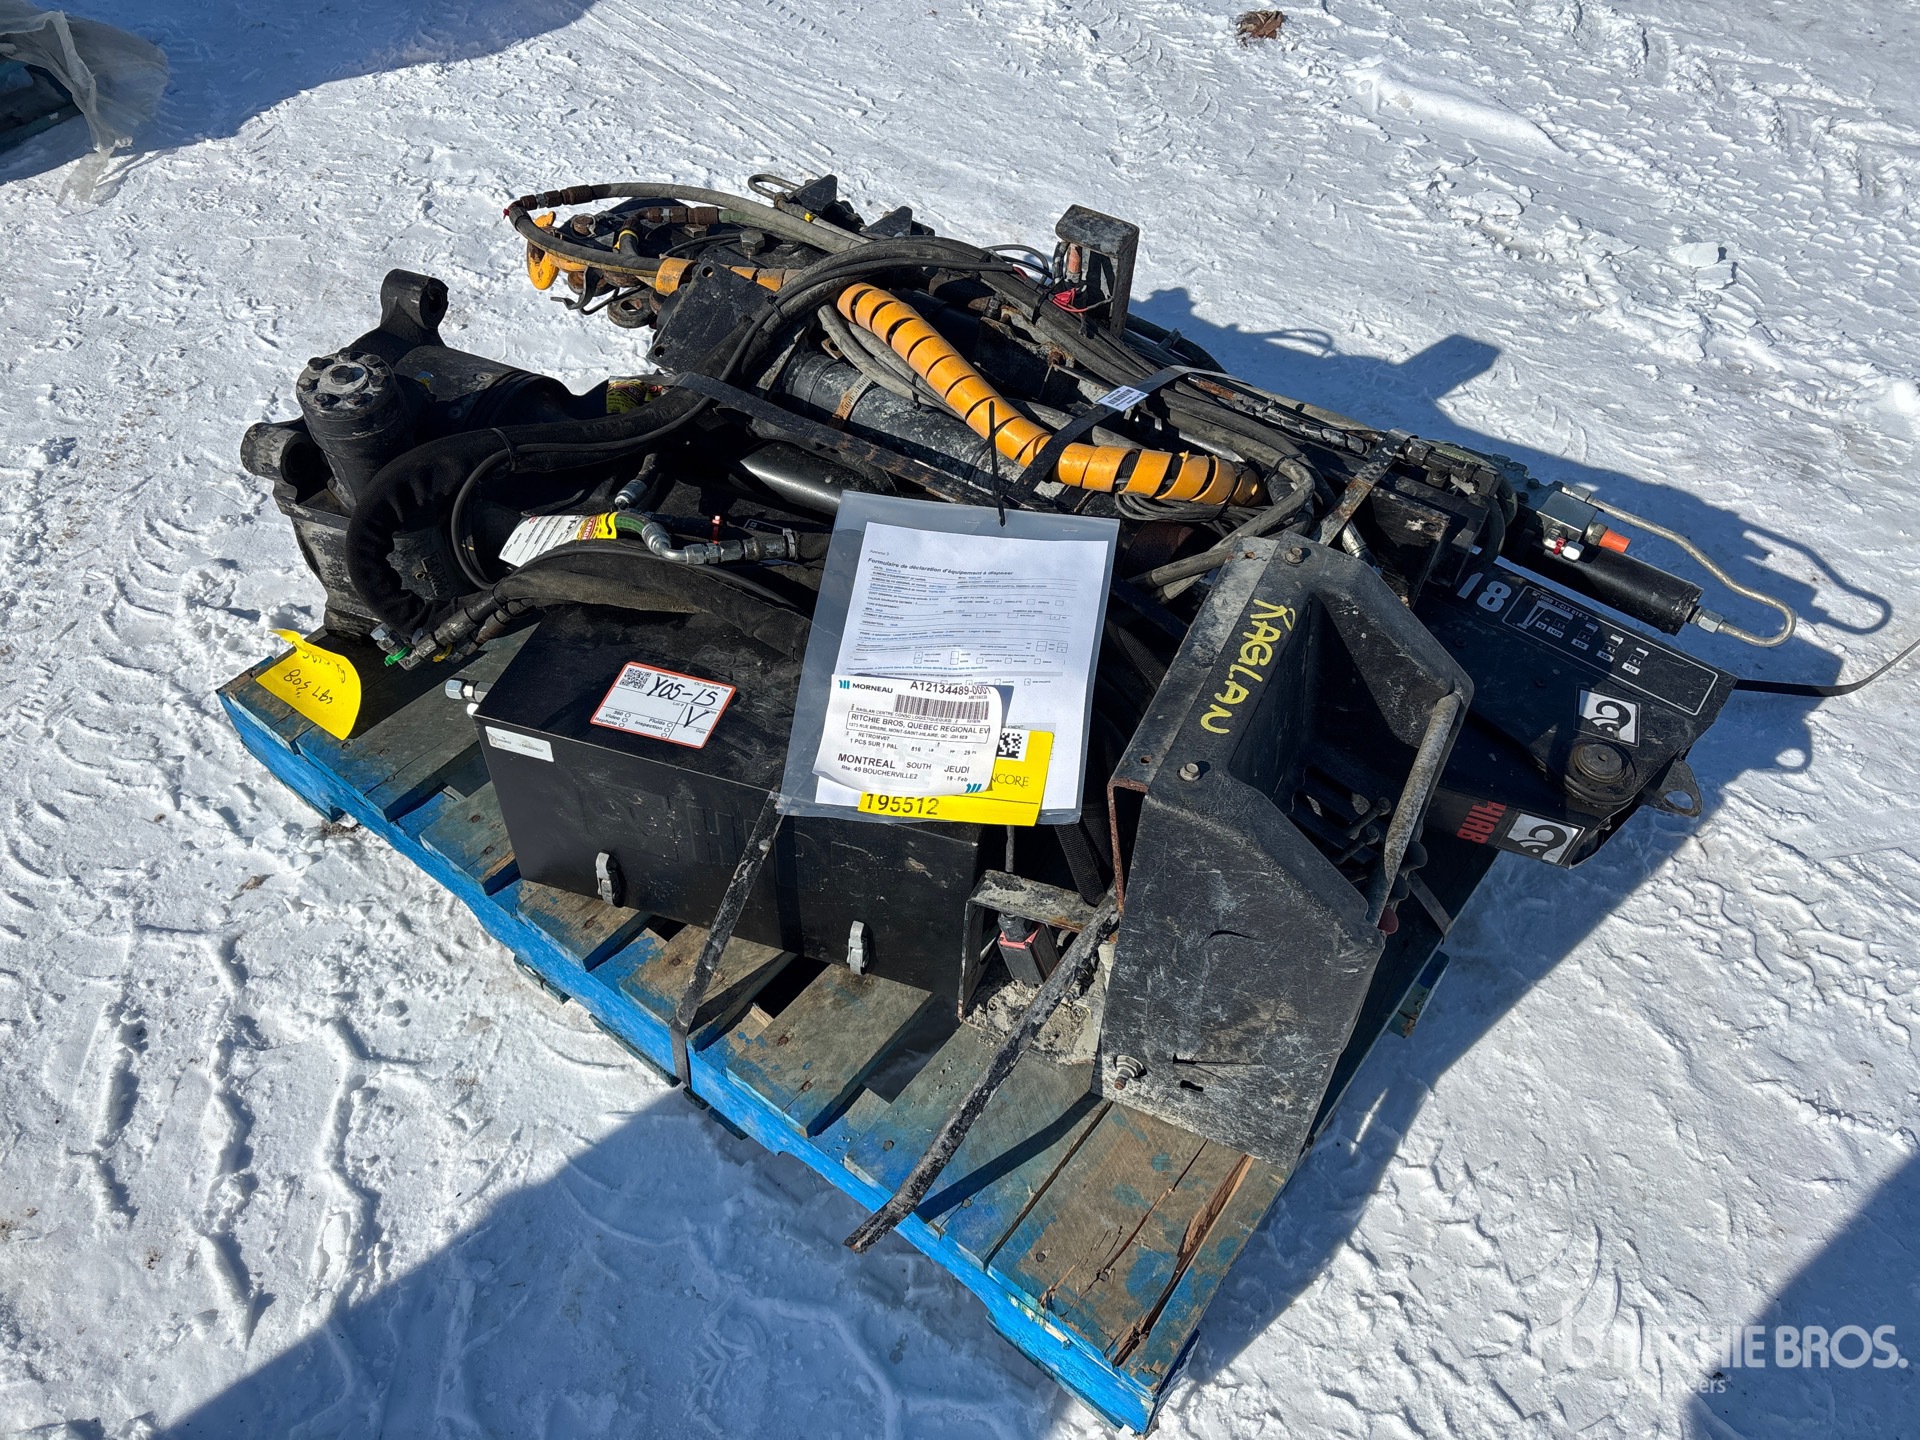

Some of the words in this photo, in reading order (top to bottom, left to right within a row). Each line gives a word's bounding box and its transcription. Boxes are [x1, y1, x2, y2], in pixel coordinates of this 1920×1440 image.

[867, 557, 899, 568] Formulaire
[909, 564, 941, 573] déclaration
[942, 568, 982, 576] d'équipement
[1456, 572, 1512, 613] 18
[1200, 598, 1296, 734] RAGLAN
[852, 683, 893, 694] MORNEAU
[910, 681, 991, 695] A12134489-0001
[595, 717, 618, 726] Rephoto
[634, 720, 663, 730] Inspection
[648, 718, 666, 726] Fluids
[851, 713, 881, 724] RITCHIE
[882, 718, 905, 729] BROS,
[907, 721, 939, 731] QUEBEC
[940, 725, 978, 734] REGIONAL
[867, 740, 881, 748] SUR
[837, 753, 896, 769] MONTREAL
[906, 761, 932, 770] SOUTH
[944, 765, 970, 774] JEUDI
[866, 793, 940, 815] 195512
[1457, 800, 1507, 844] HIAB
